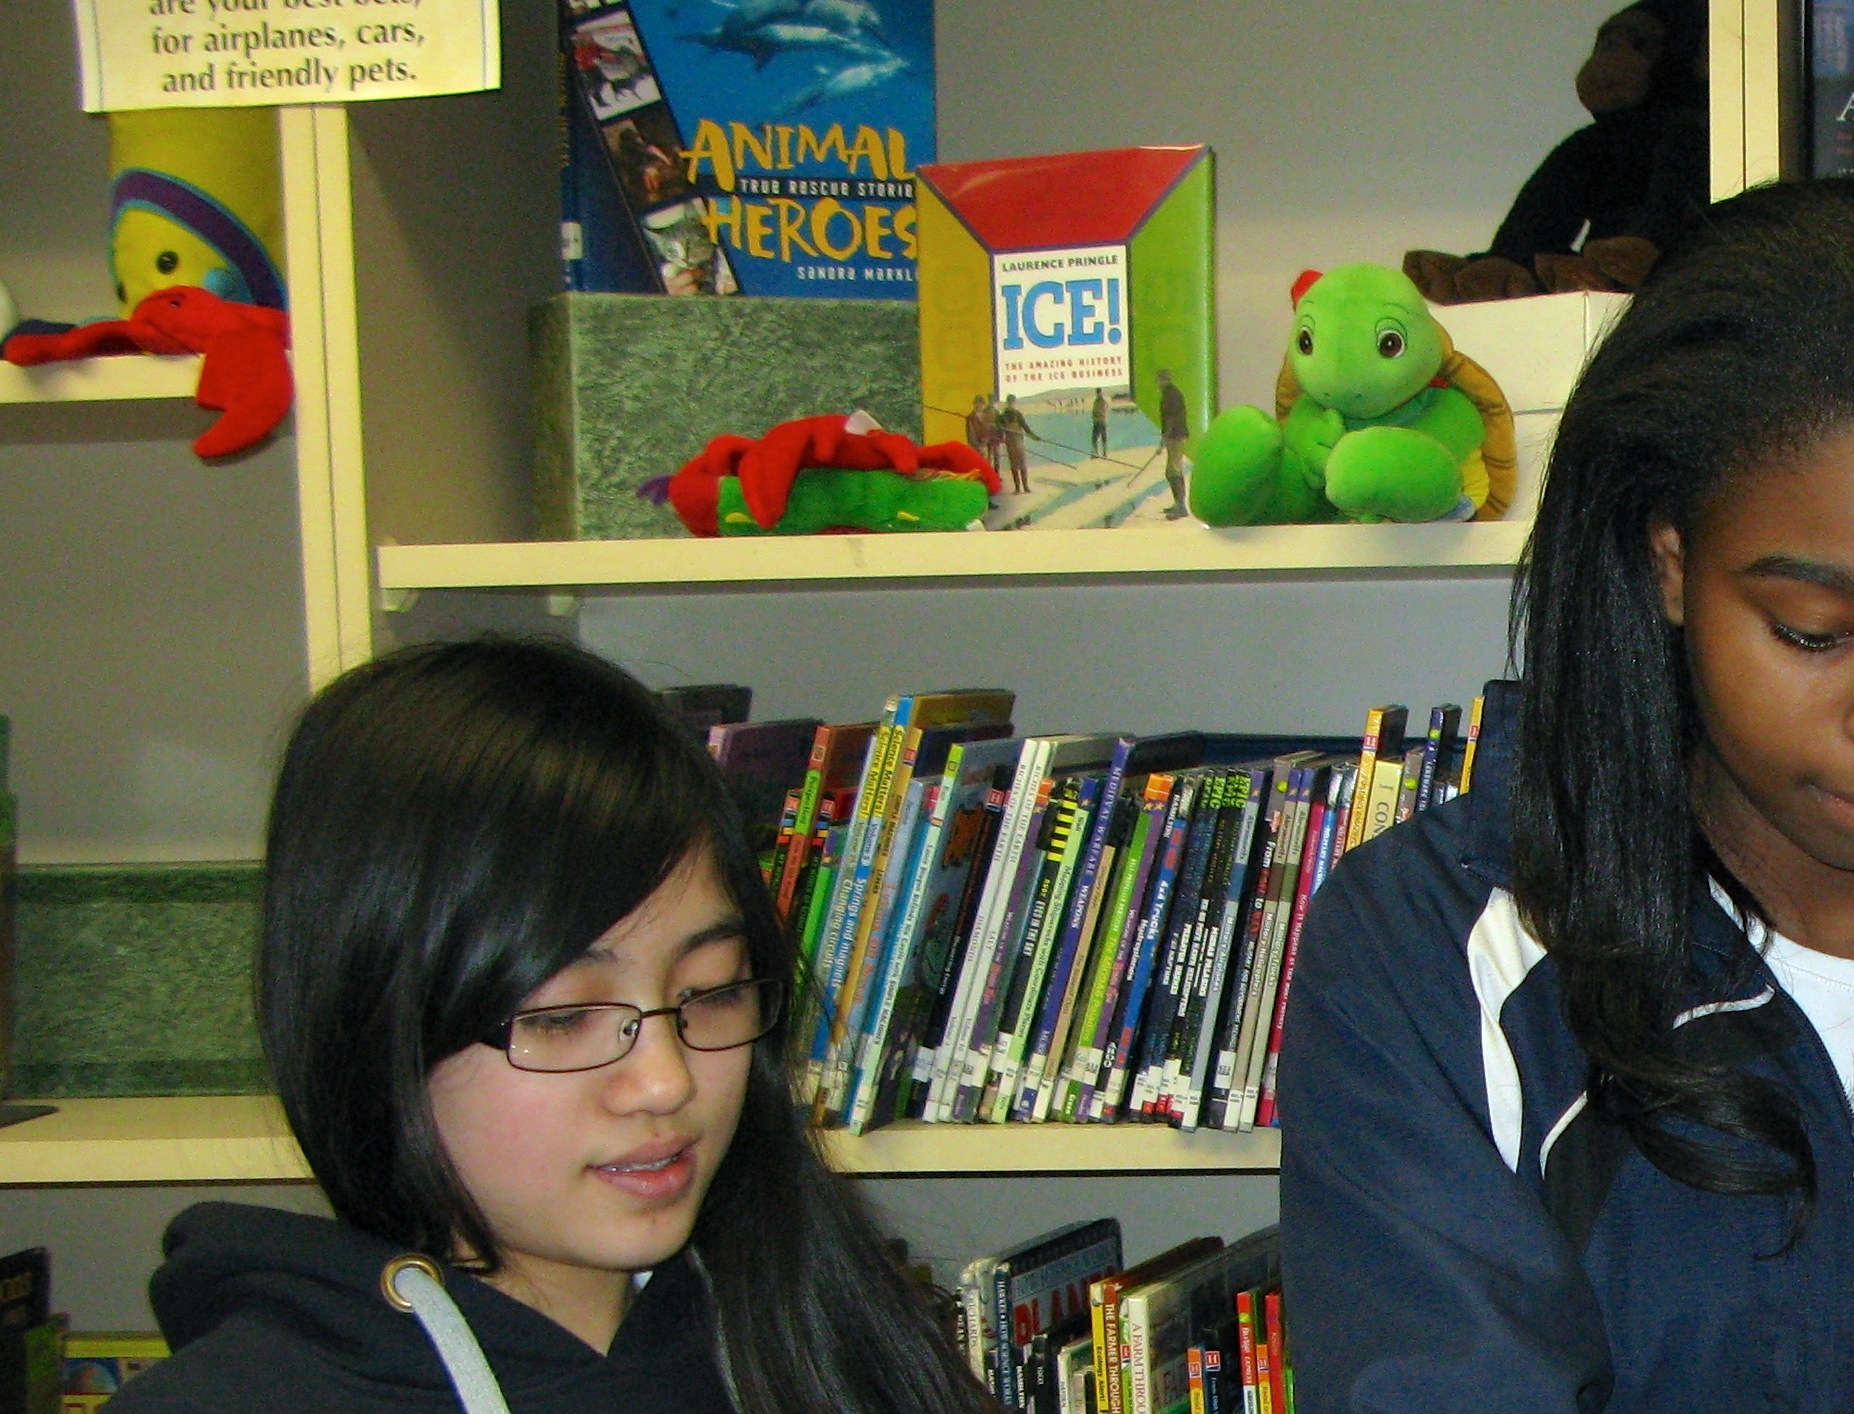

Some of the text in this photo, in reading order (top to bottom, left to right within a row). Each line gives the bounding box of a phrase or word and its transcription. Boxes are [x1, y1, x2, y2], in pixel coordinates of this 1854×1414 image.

[152, 21, 425, 59] for airplanes, cars,
[162, 57, 417, 93] and friendly pets.
[678, 118, 916, 192] ANIMAL
[739, 178, 781, 194] TRUE
[789, 180, 849, 196] RESCUE
[701, 193, 918, 263] HEROES
[1002, 255, 1118, 272] LAURENCE PRINGLE
[1001, 278, 1123, 350] ICE!
[1005, 356, 1122, 371] THE AMAZING HISTORY
[1005, 368, 1123, 383] OF THE ICE BUSINESS
[860, 727, 888, 817] Science Matters!
[874, 728, 902, 816] Science Matters!
[1071, 765, 1120, 928] MEDIEVAL WARFARE WEAPONS
[848, 876, 866, 918] Springs
[1146, 879, 1169, 940] 4x4 Trucks
[823, 878, 852, 969] Changing circuits
[842, 919, 855, 943] and
[1126, 918, 1147, 981] Hydroplanes
[1105, 1303, 1114, 1321] THE
[1131, 1323, 1140, 1331] A
[1106, 1323, 1117, 1363] FARMER
[1132, 1333, 1142, 1366] FARM
[1108, 1365, 1120, 1414] THROUGH
